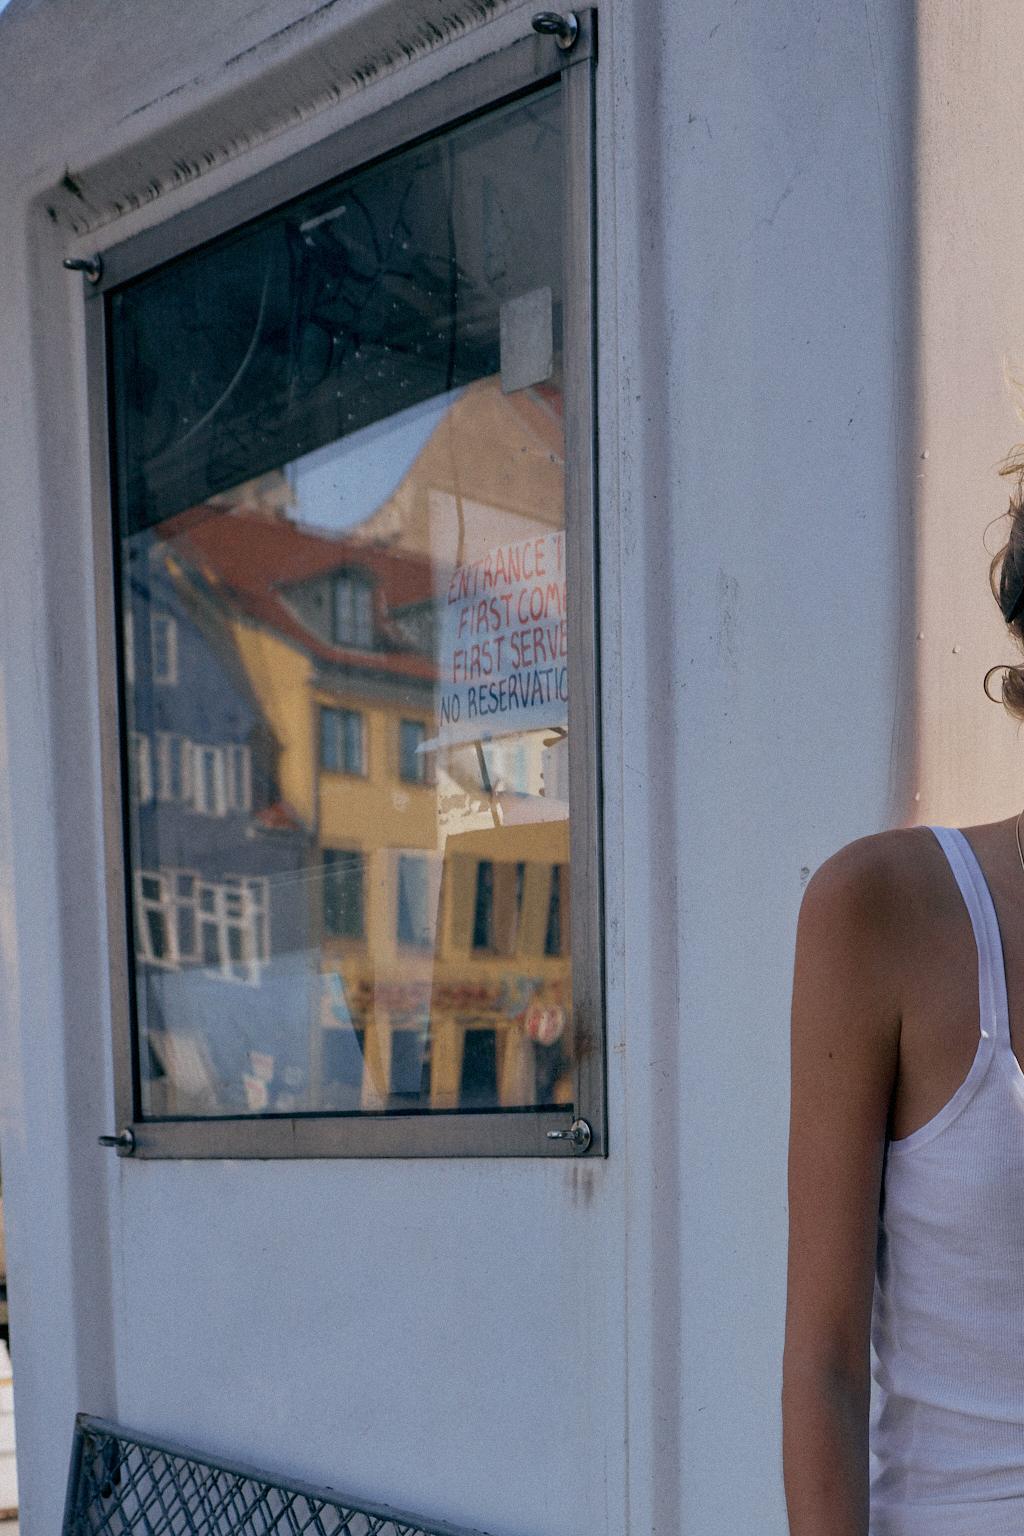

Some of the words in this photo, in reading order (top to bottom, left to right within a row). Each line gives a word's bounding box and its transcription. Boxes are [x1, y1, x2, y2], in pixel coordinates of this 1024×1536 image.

[447, 537, 546, 606] ENTRANCE
[458, 592, 513, 639] FIRST
[517, 582, 567, 625] COM
[453, 635, 505, 684] FIRST
[440, 693, 461, 727] NO
